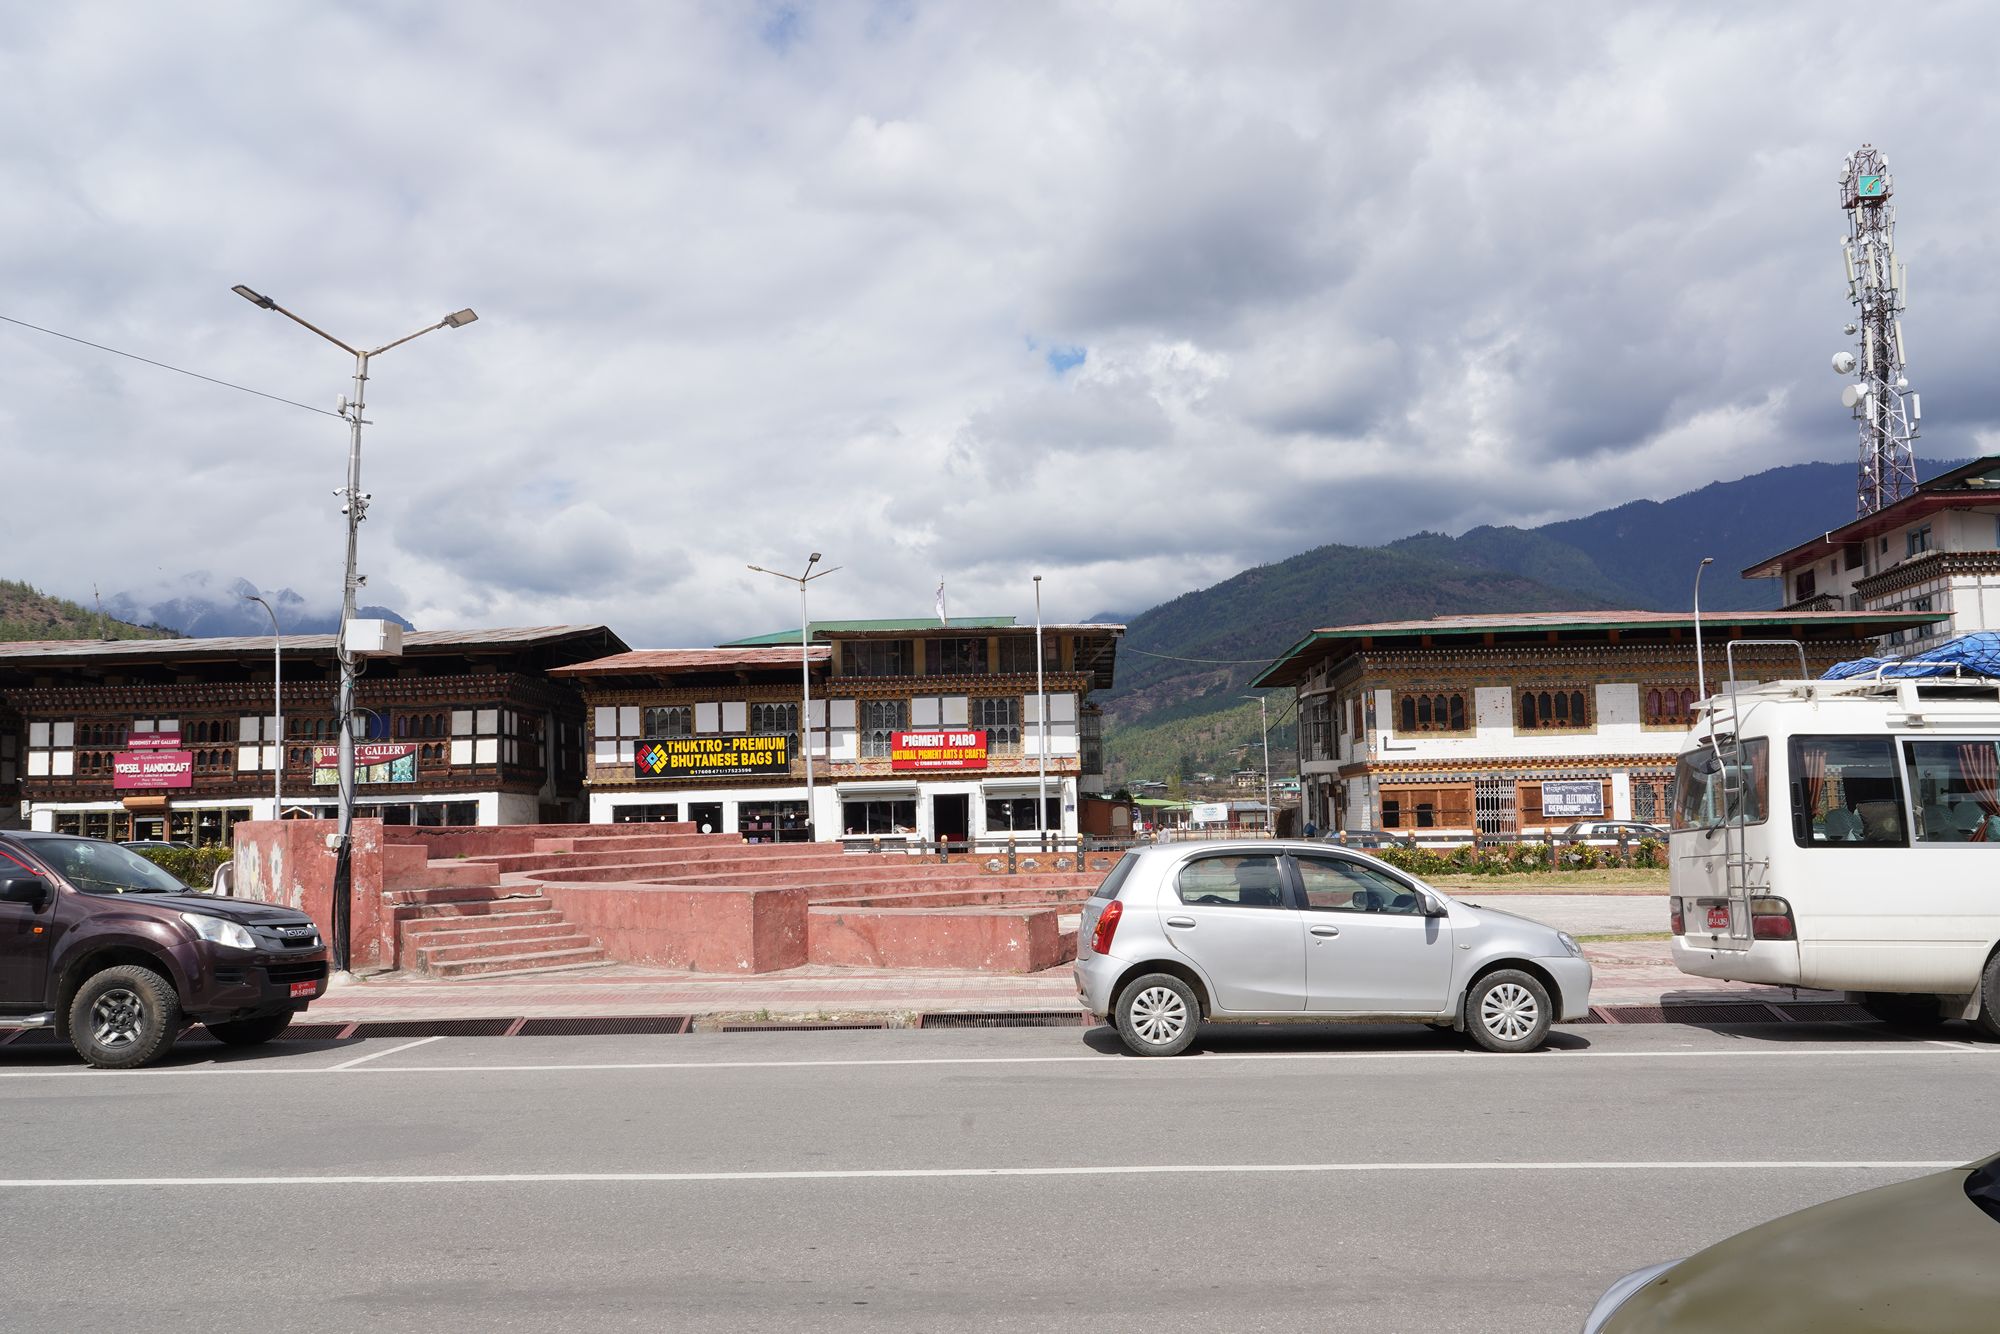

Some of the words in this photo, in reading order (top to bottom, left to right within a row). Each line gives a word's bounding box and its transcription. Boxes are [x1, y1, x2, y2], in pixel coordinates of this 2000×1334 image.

[667, 740, 723, 753] THUKTRO
[732, 738, 785, 751] PREMIUM
[902, 735, 945, 747] PIGMENT
[949, 734, 976, 746] PARO
[323, 747, 337, 757] UR
[365, 745, 407, 756] GALLERY
[892, 750, 917, 760] NATURAL
[918, 749, 942, 760] PIGMENT
[943, 749, 958, 759] ARTS
[959, 749, 964, 759] &
[965, 748, 986, 759] CRAFTS
[671, 753, 739, 768] BHUTANESE
[741, 752, 773, 766] BAGS
[115, 763, 141, 773] YOESEL
[143, 762, 191, 773] HANDICRAFT
[1548, 804, 1581, 812] REPAIRING
[287, 929, 309, 937] ISUZU
